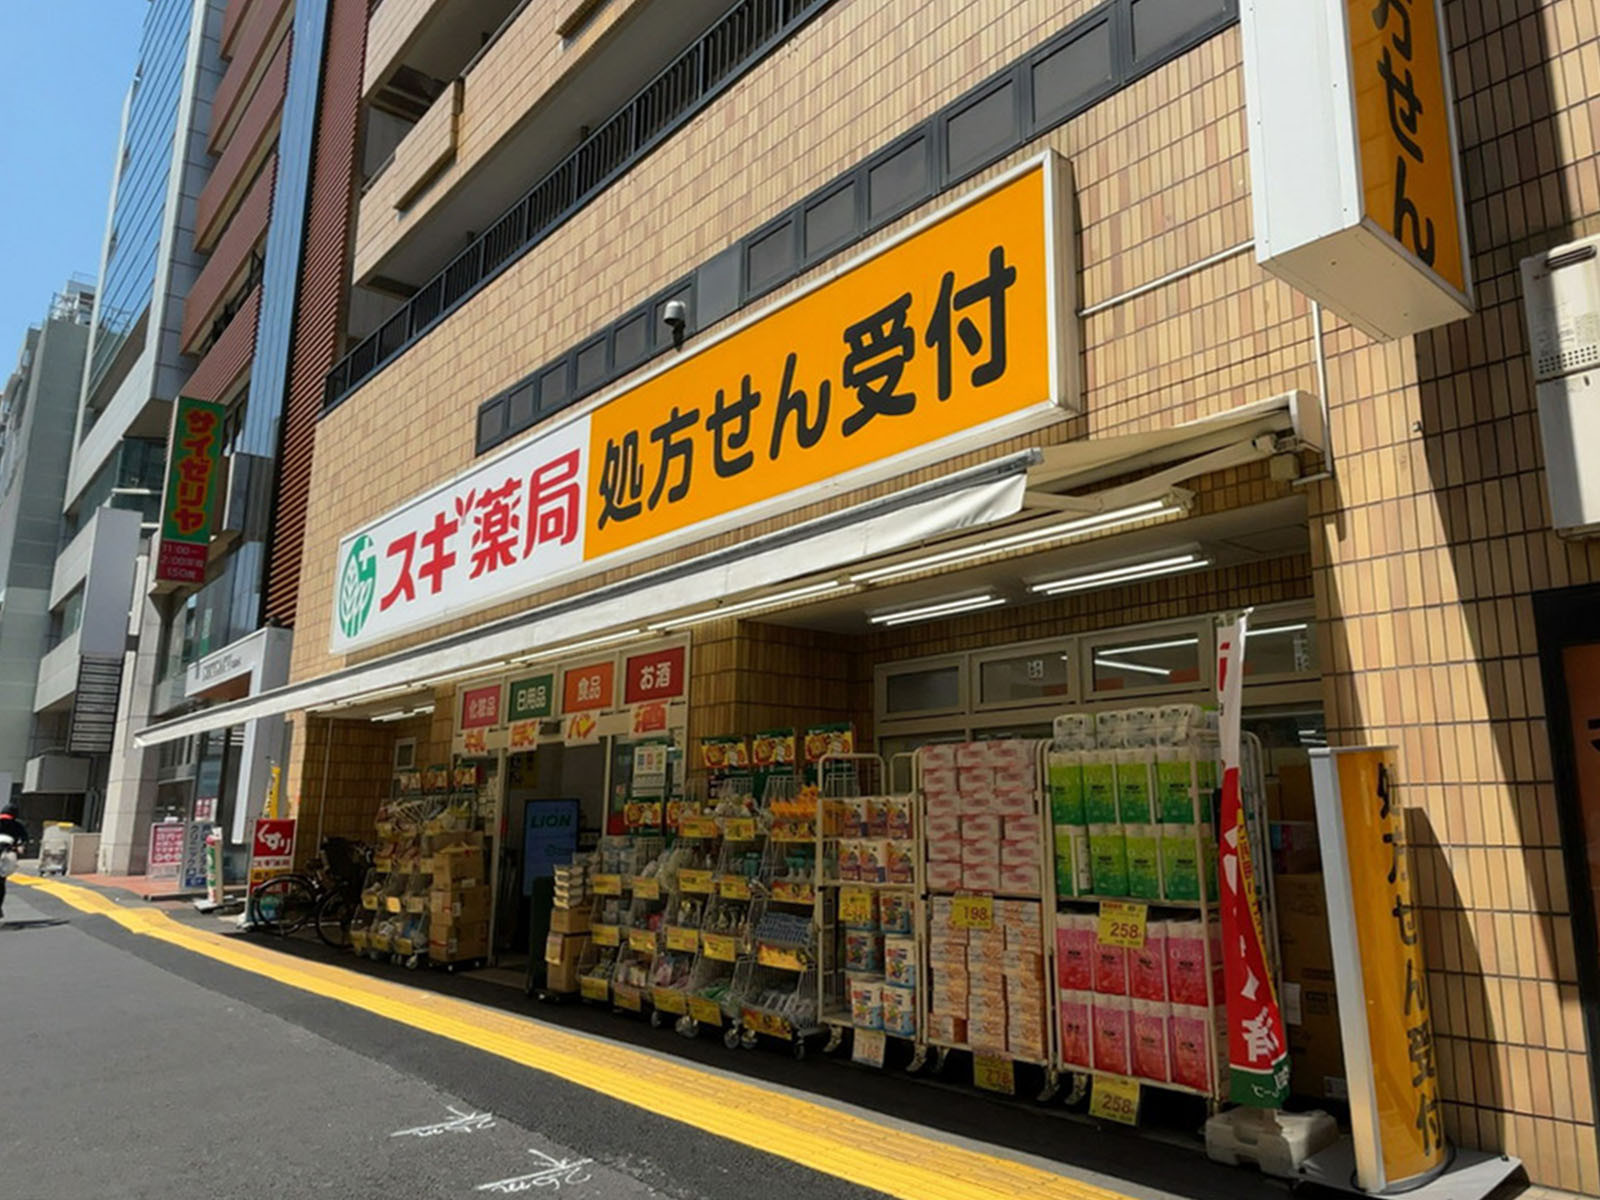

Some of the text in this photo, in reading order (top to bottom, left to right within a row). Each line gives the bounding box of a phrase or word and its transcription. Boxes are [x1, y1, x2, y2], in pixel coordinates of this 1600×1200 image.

[598, 245, 1017, 531] 処方せん受付
[172, 409, 216, 534] サイゼリヤ
[380, 448, 581, 612] スギ薬局
[577, 675, 601, 702] 食品
[639, 661, 672, 691] お酒
[516, 685, 547, 712] 日用品
[531, 814, 571, 828] LION
[964, 906, 988, 921] 198
[1110, 922, 1139, 939] 258
[1102, 1093, 1132, 1114] 258
